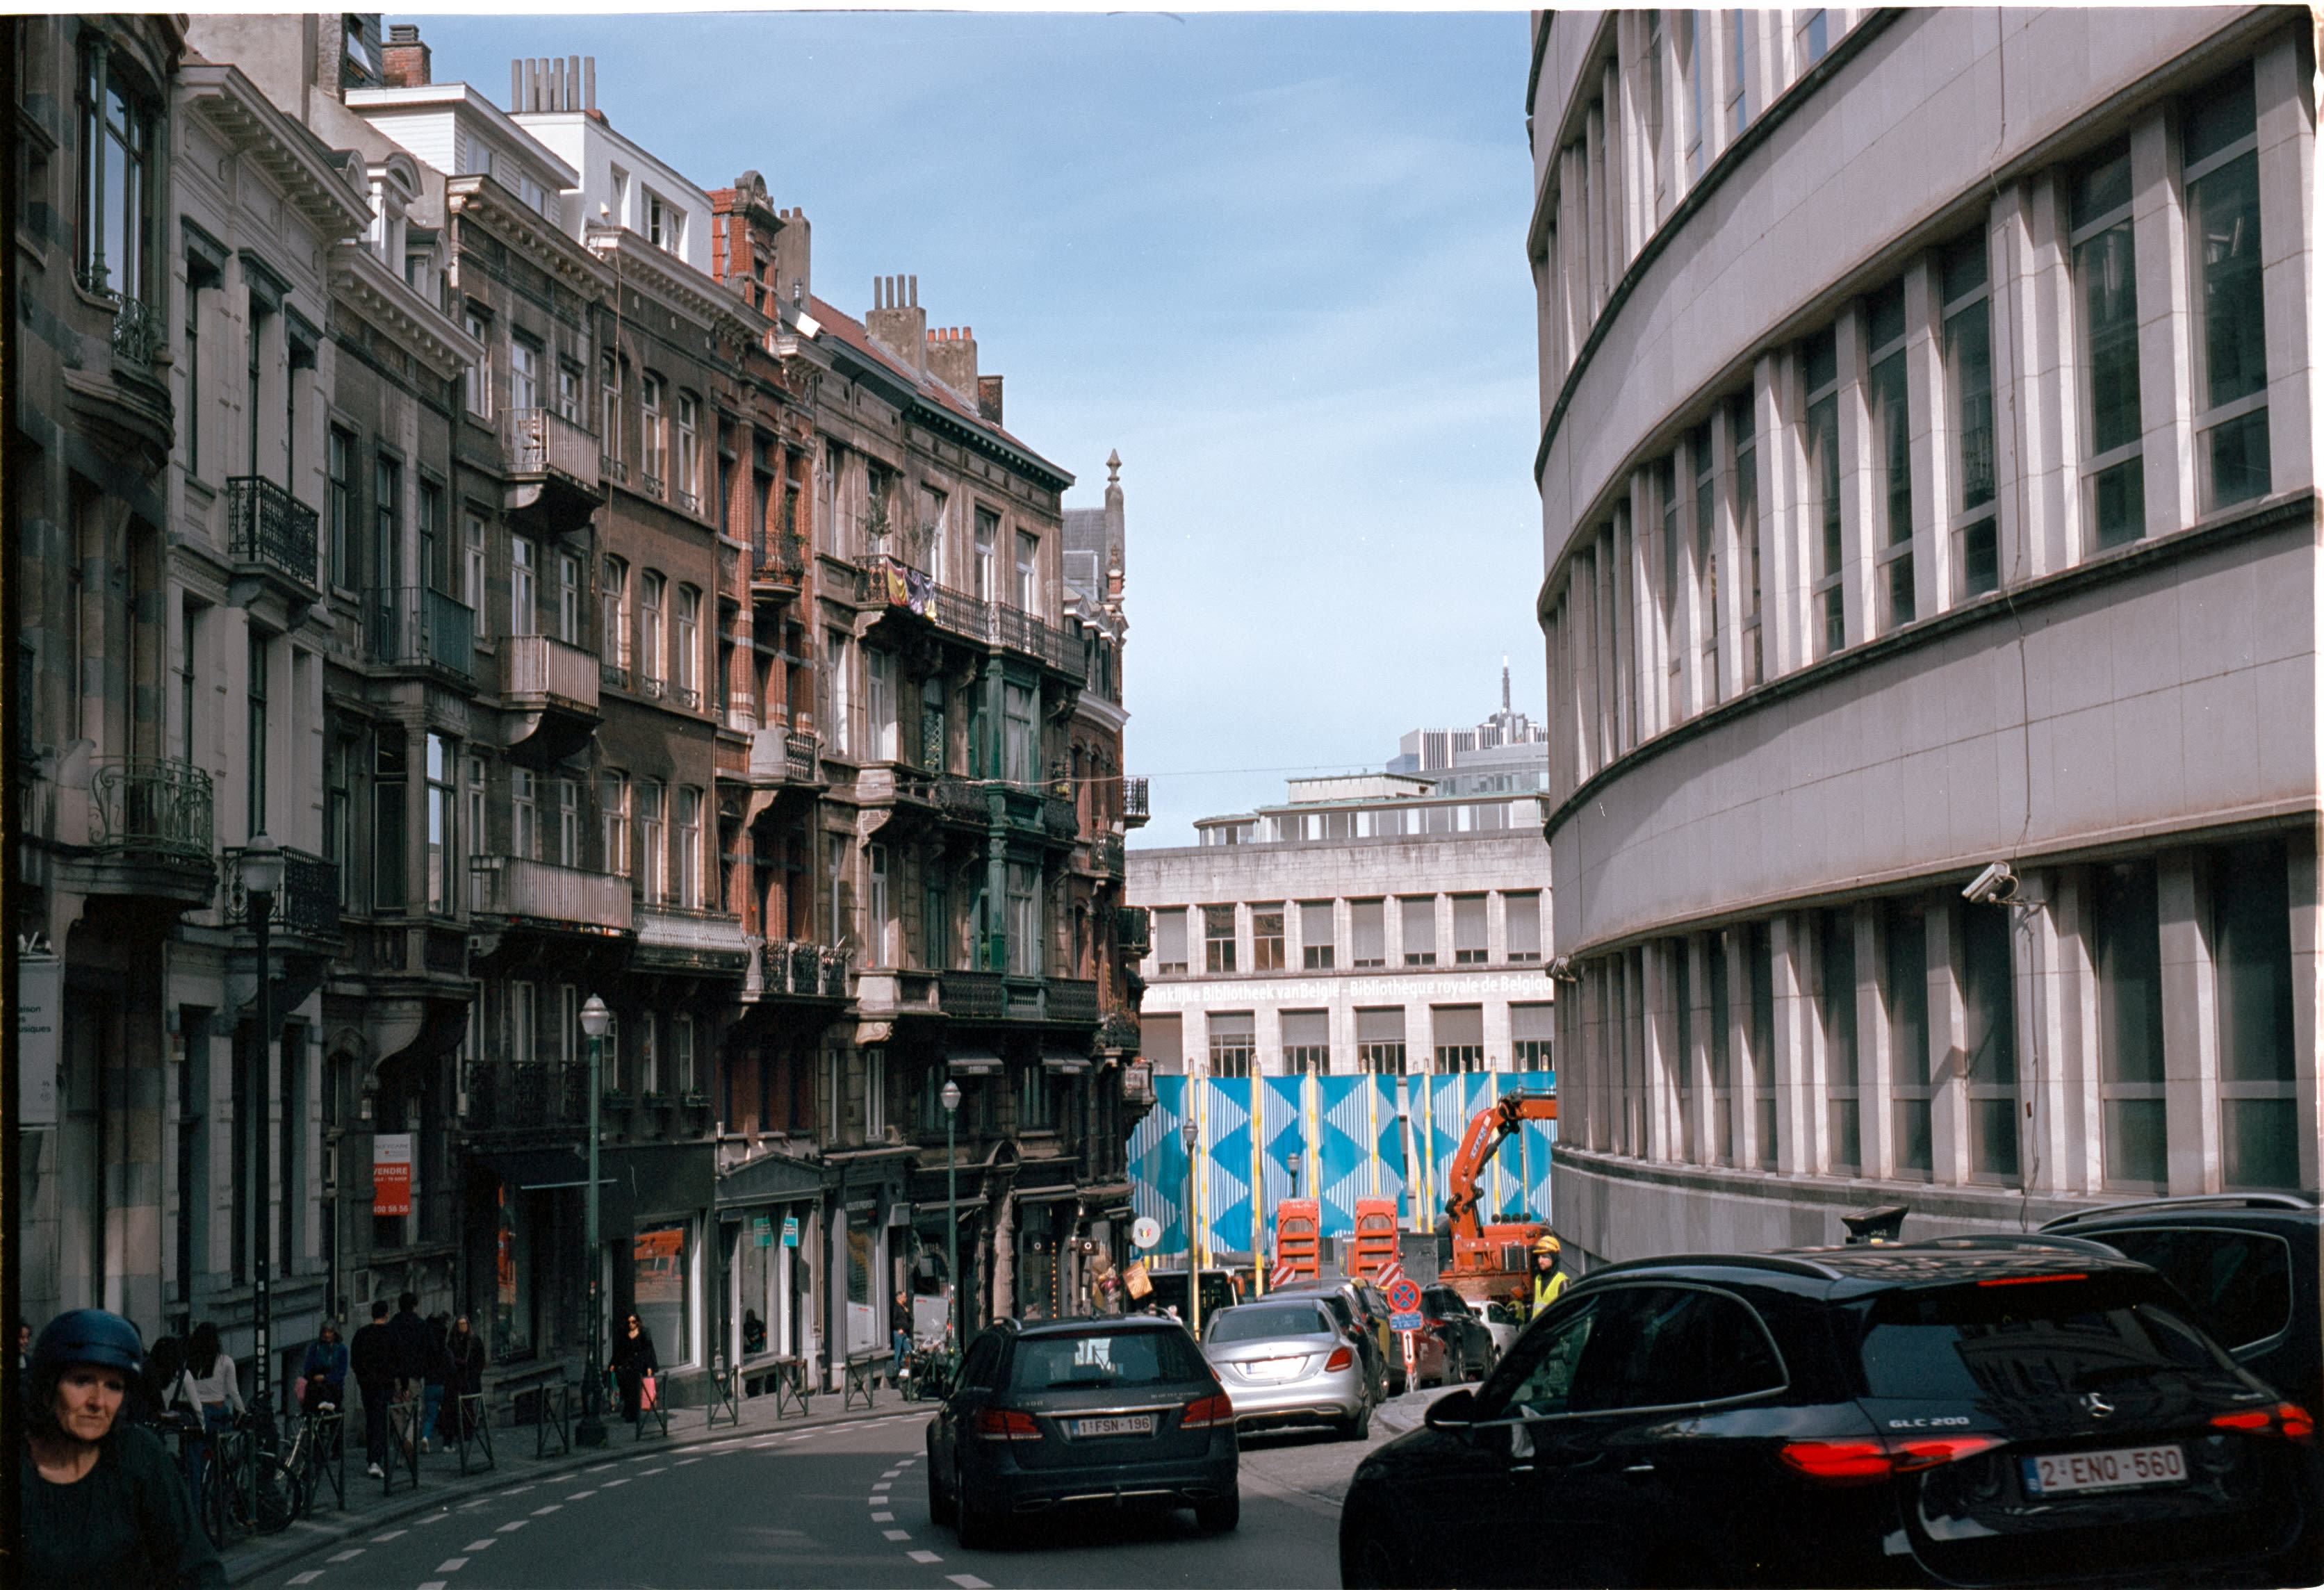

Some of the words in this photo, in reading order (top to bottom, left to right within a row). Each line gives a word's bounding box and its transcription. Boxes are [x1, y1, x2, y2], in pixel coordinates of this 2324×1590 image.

[1203, 984, 1274, 1001] Bibliotheek
[1277, 986, 1300, 999] van
[1300, 981, 1340, 1001] België
[1350, 978, 1434, 998] Bibliothèque
[1437, 976, 1478, 997] royale
[1481, 976, 1497, 992] de
[1889, 1419, 1927, 1428] GLC
[1930, 1417, 1970, 1426] 200
